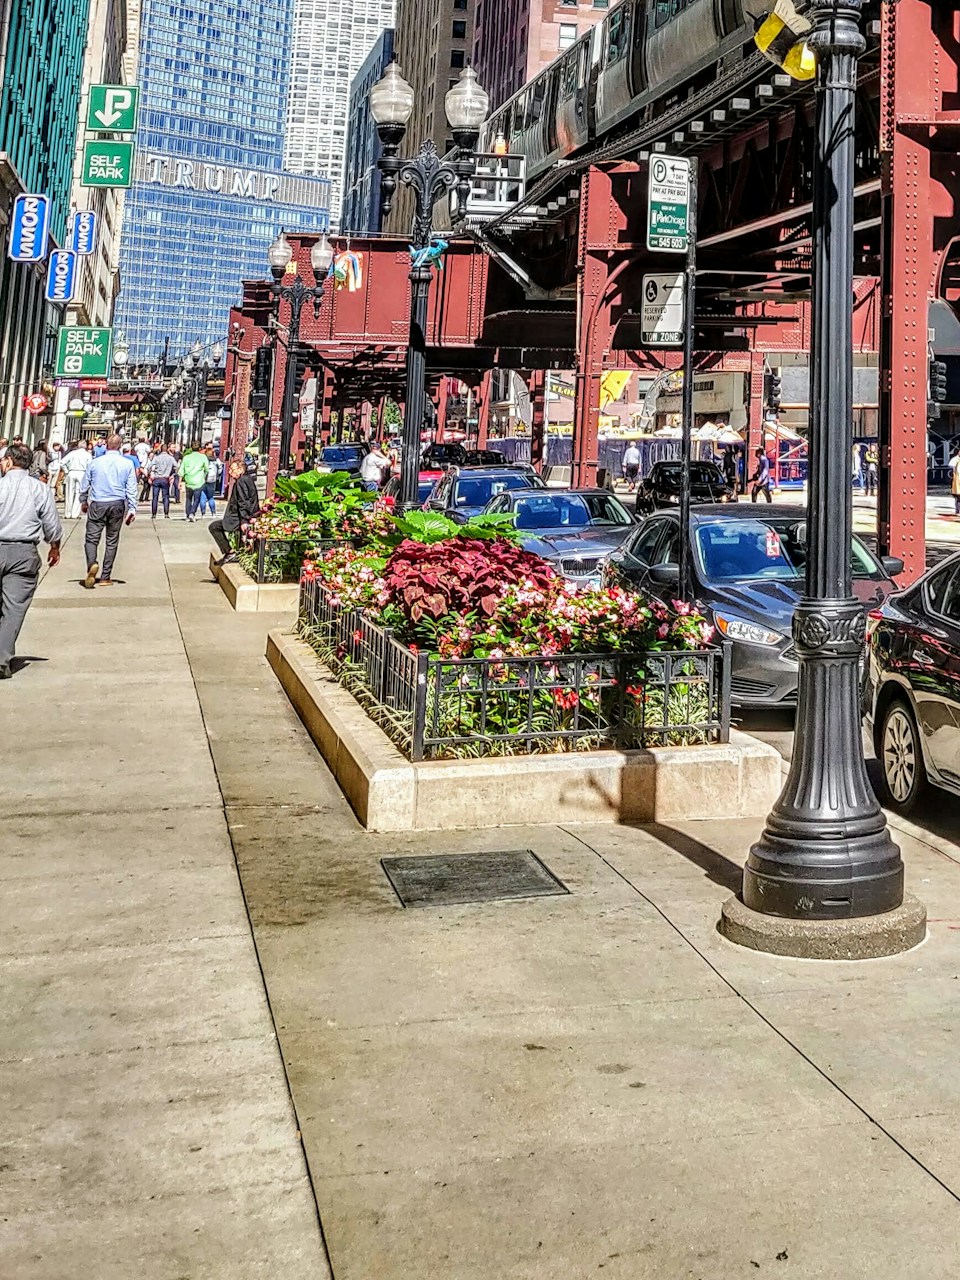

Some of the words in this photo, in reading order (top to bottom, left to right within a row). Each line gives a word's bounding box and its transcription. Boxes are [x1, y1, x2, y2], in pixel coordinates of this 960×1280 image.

[90, 155, 121, 167] SELF
[89, 167, 123, 179] PARK
[147, 154, 281, 202] TRUMP
[19, 198, 39, 258] ROSS
[78, 212, 91, 253] ROSS
[54, 252, 68, 298] ROSS
[67, 331, 100, 343] SELF
[646, 332, 658, 341] TOW
[660, 332, 679, 340] ZONE
[65, 343, 103, 356] PARK
